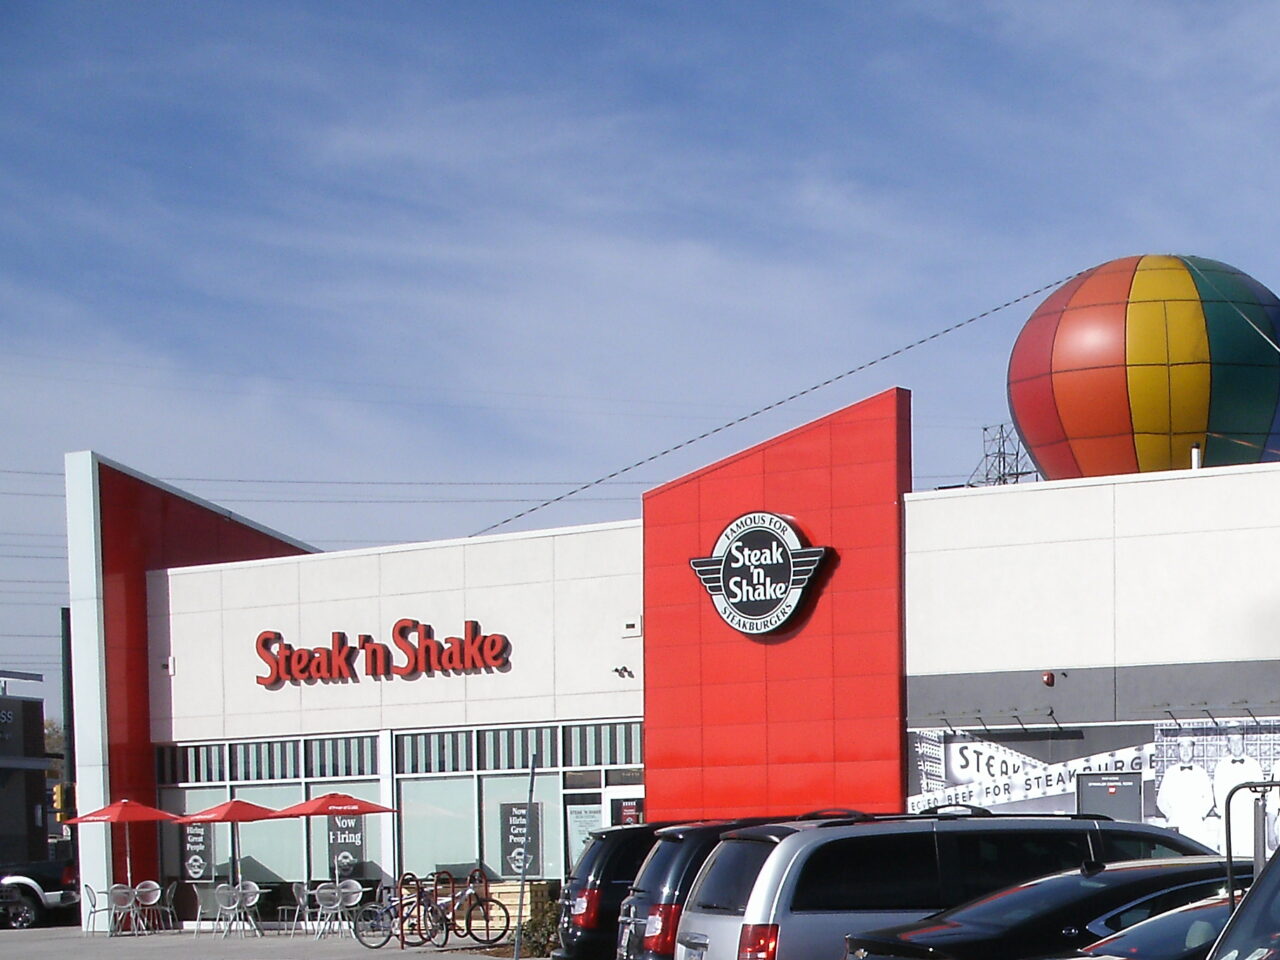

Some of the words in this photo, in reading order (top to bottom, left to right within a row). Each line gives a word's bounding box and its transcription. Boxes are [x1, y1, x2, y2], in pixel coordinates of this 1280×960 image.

[724, 514, 766, 541] FAMOUS
[768, 516, 788, 536] FOR
[731, 541, 784, 568] Steak
[728, 577, 787, 604] Shake
[722, 603, 793, 632] STEAKBURGERS
[255, 630, 357, 689] Steak
[392, 618, 511, 681] Shake
[985, 783, 1011, 798] FOR
[329, 831, 362, 846] Hiring
